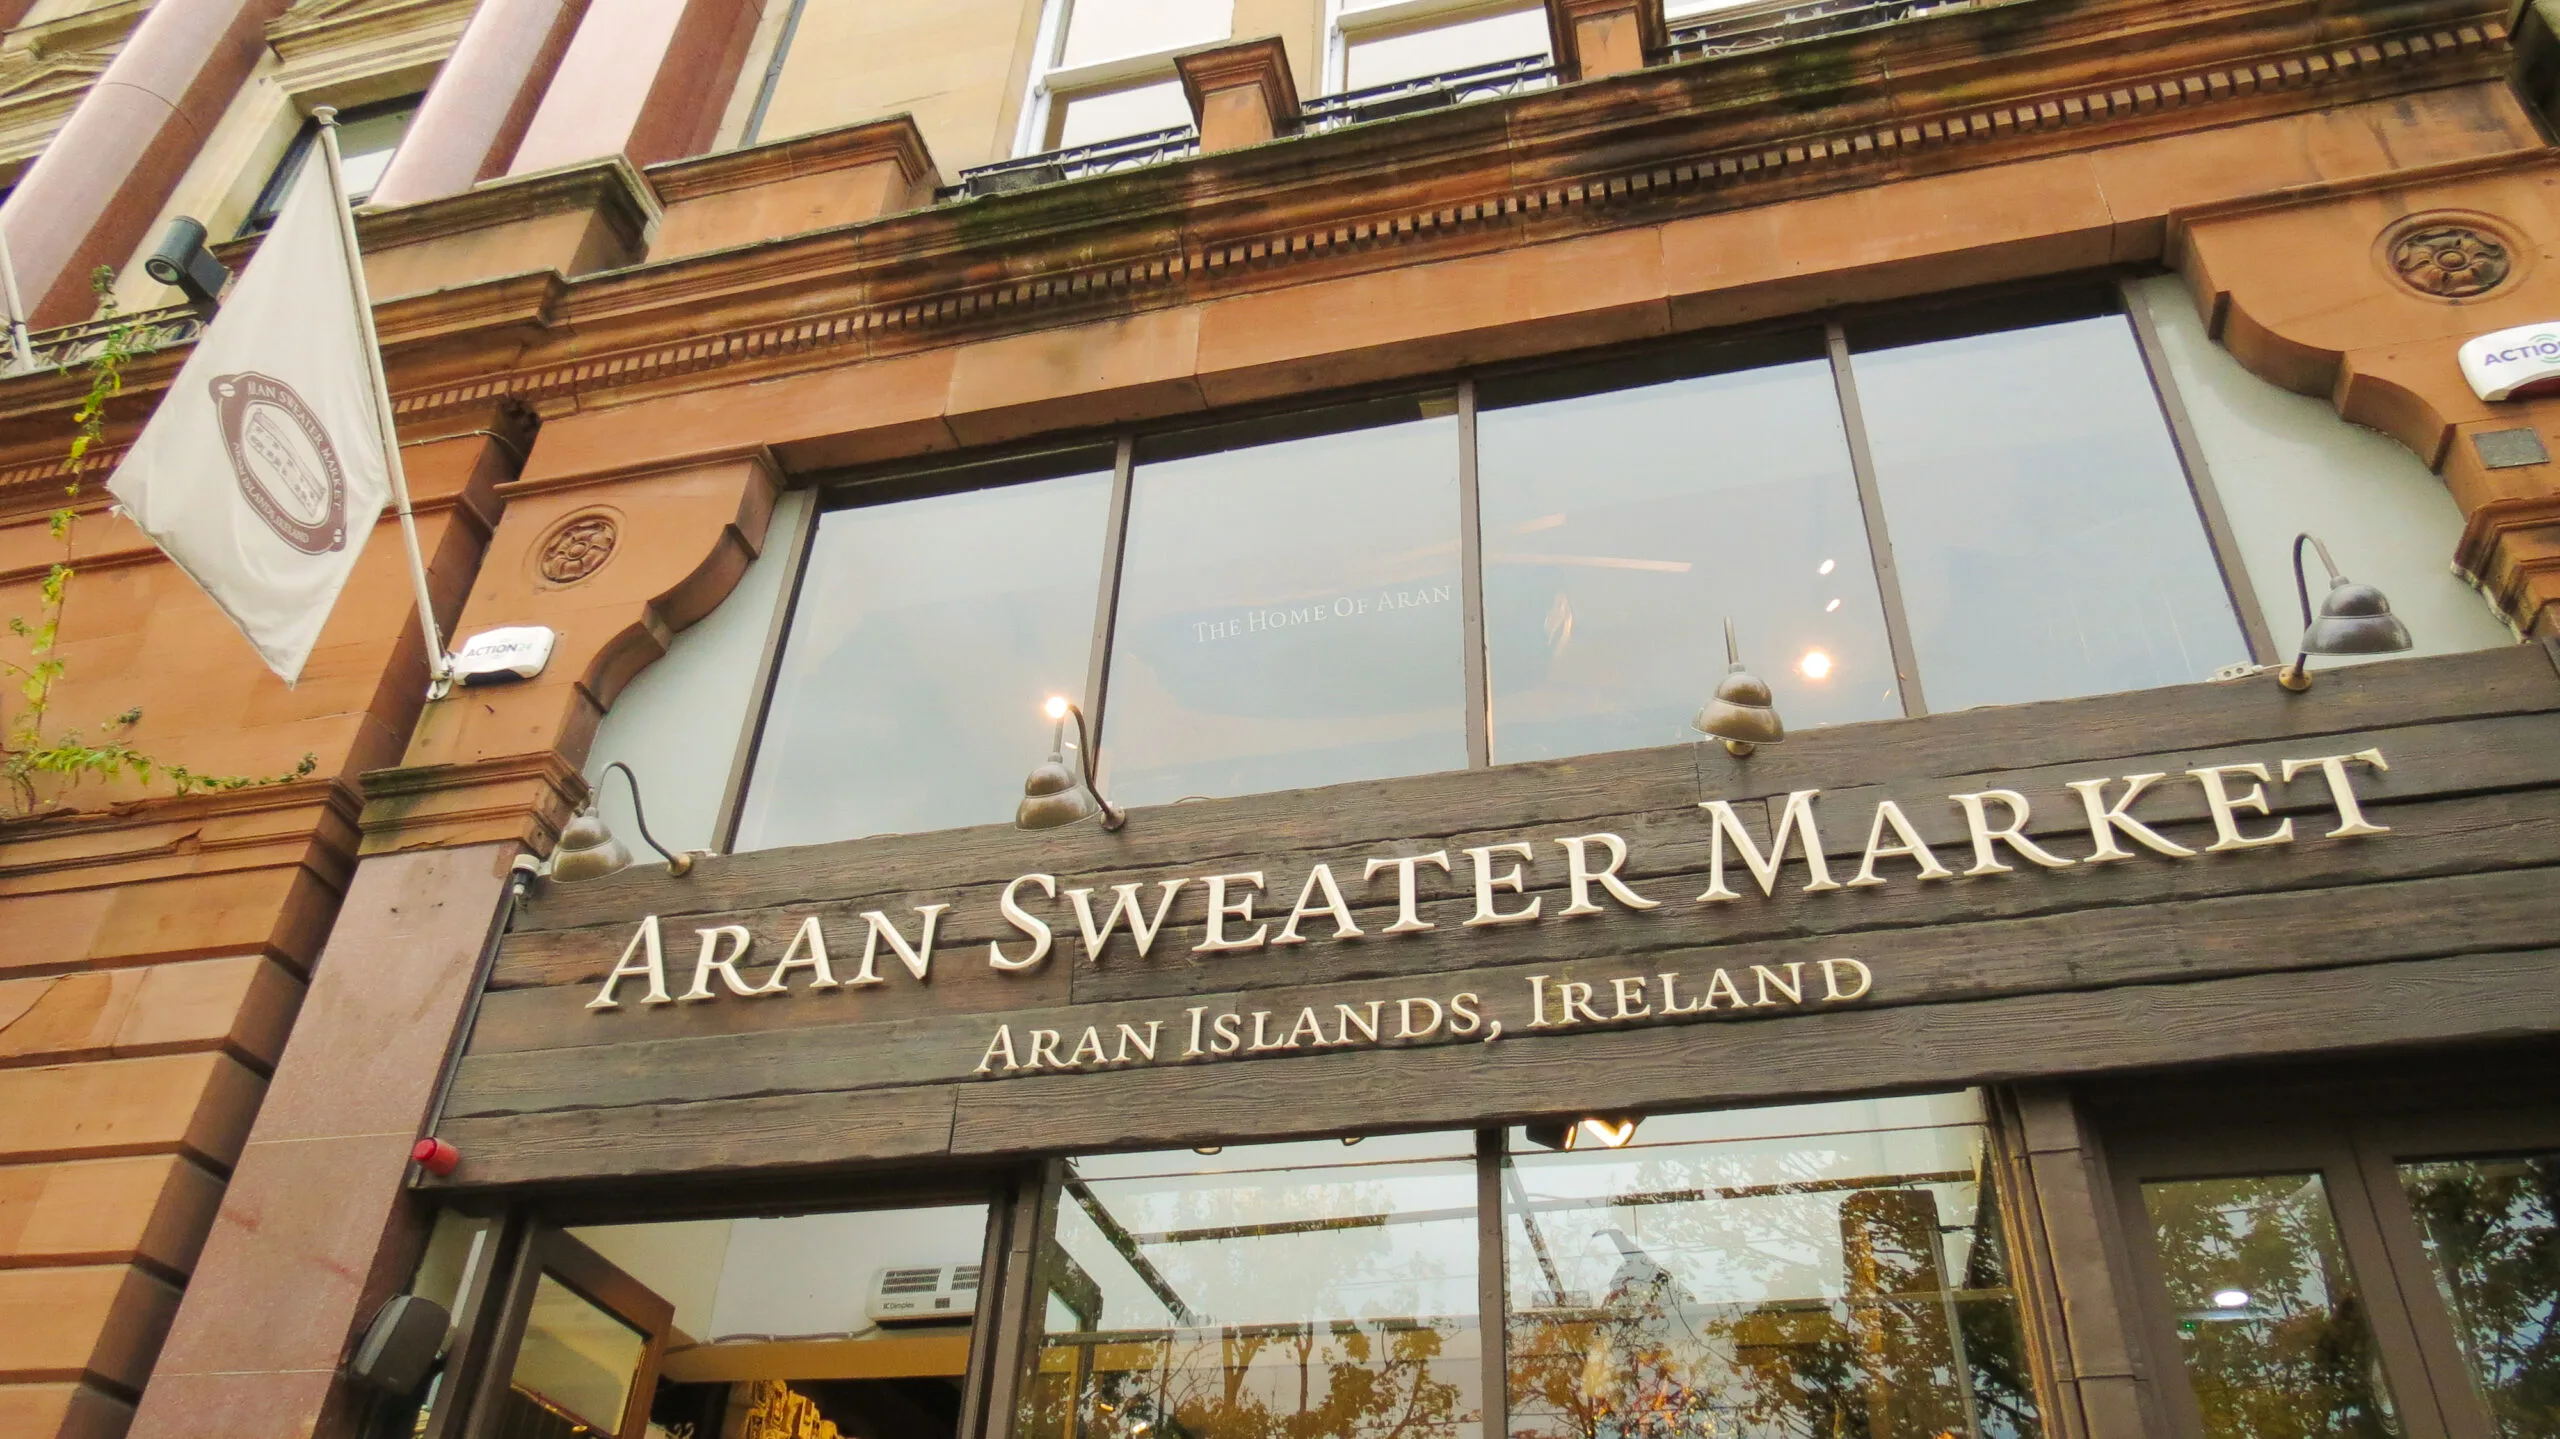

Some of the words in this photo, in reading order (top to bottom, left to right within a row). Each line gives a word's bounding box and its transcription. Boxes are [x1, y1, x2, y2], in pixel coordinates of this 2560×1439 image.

[2484, 340, 2560, 366] ACTIO
[320, 446, 344, 511] MARKET
[1192, 619, 1241, 643] THE
[1248, 604, 1327, 633] HOME
[1334, 596, 1369, 617] OF
[1377, 585, 1451, 612] ARAN
[585, 903, 951, 1009] ARAN
[989, 832, 1664, 971] SWEATER
[1694, 747, 2392, 903] MARKET
[973, 1020, 1164, 1074] ARAN
[1182, 992, 1503, 1057] ISLANDS,
[1524, 957, 1873, 1028] IRELAND
